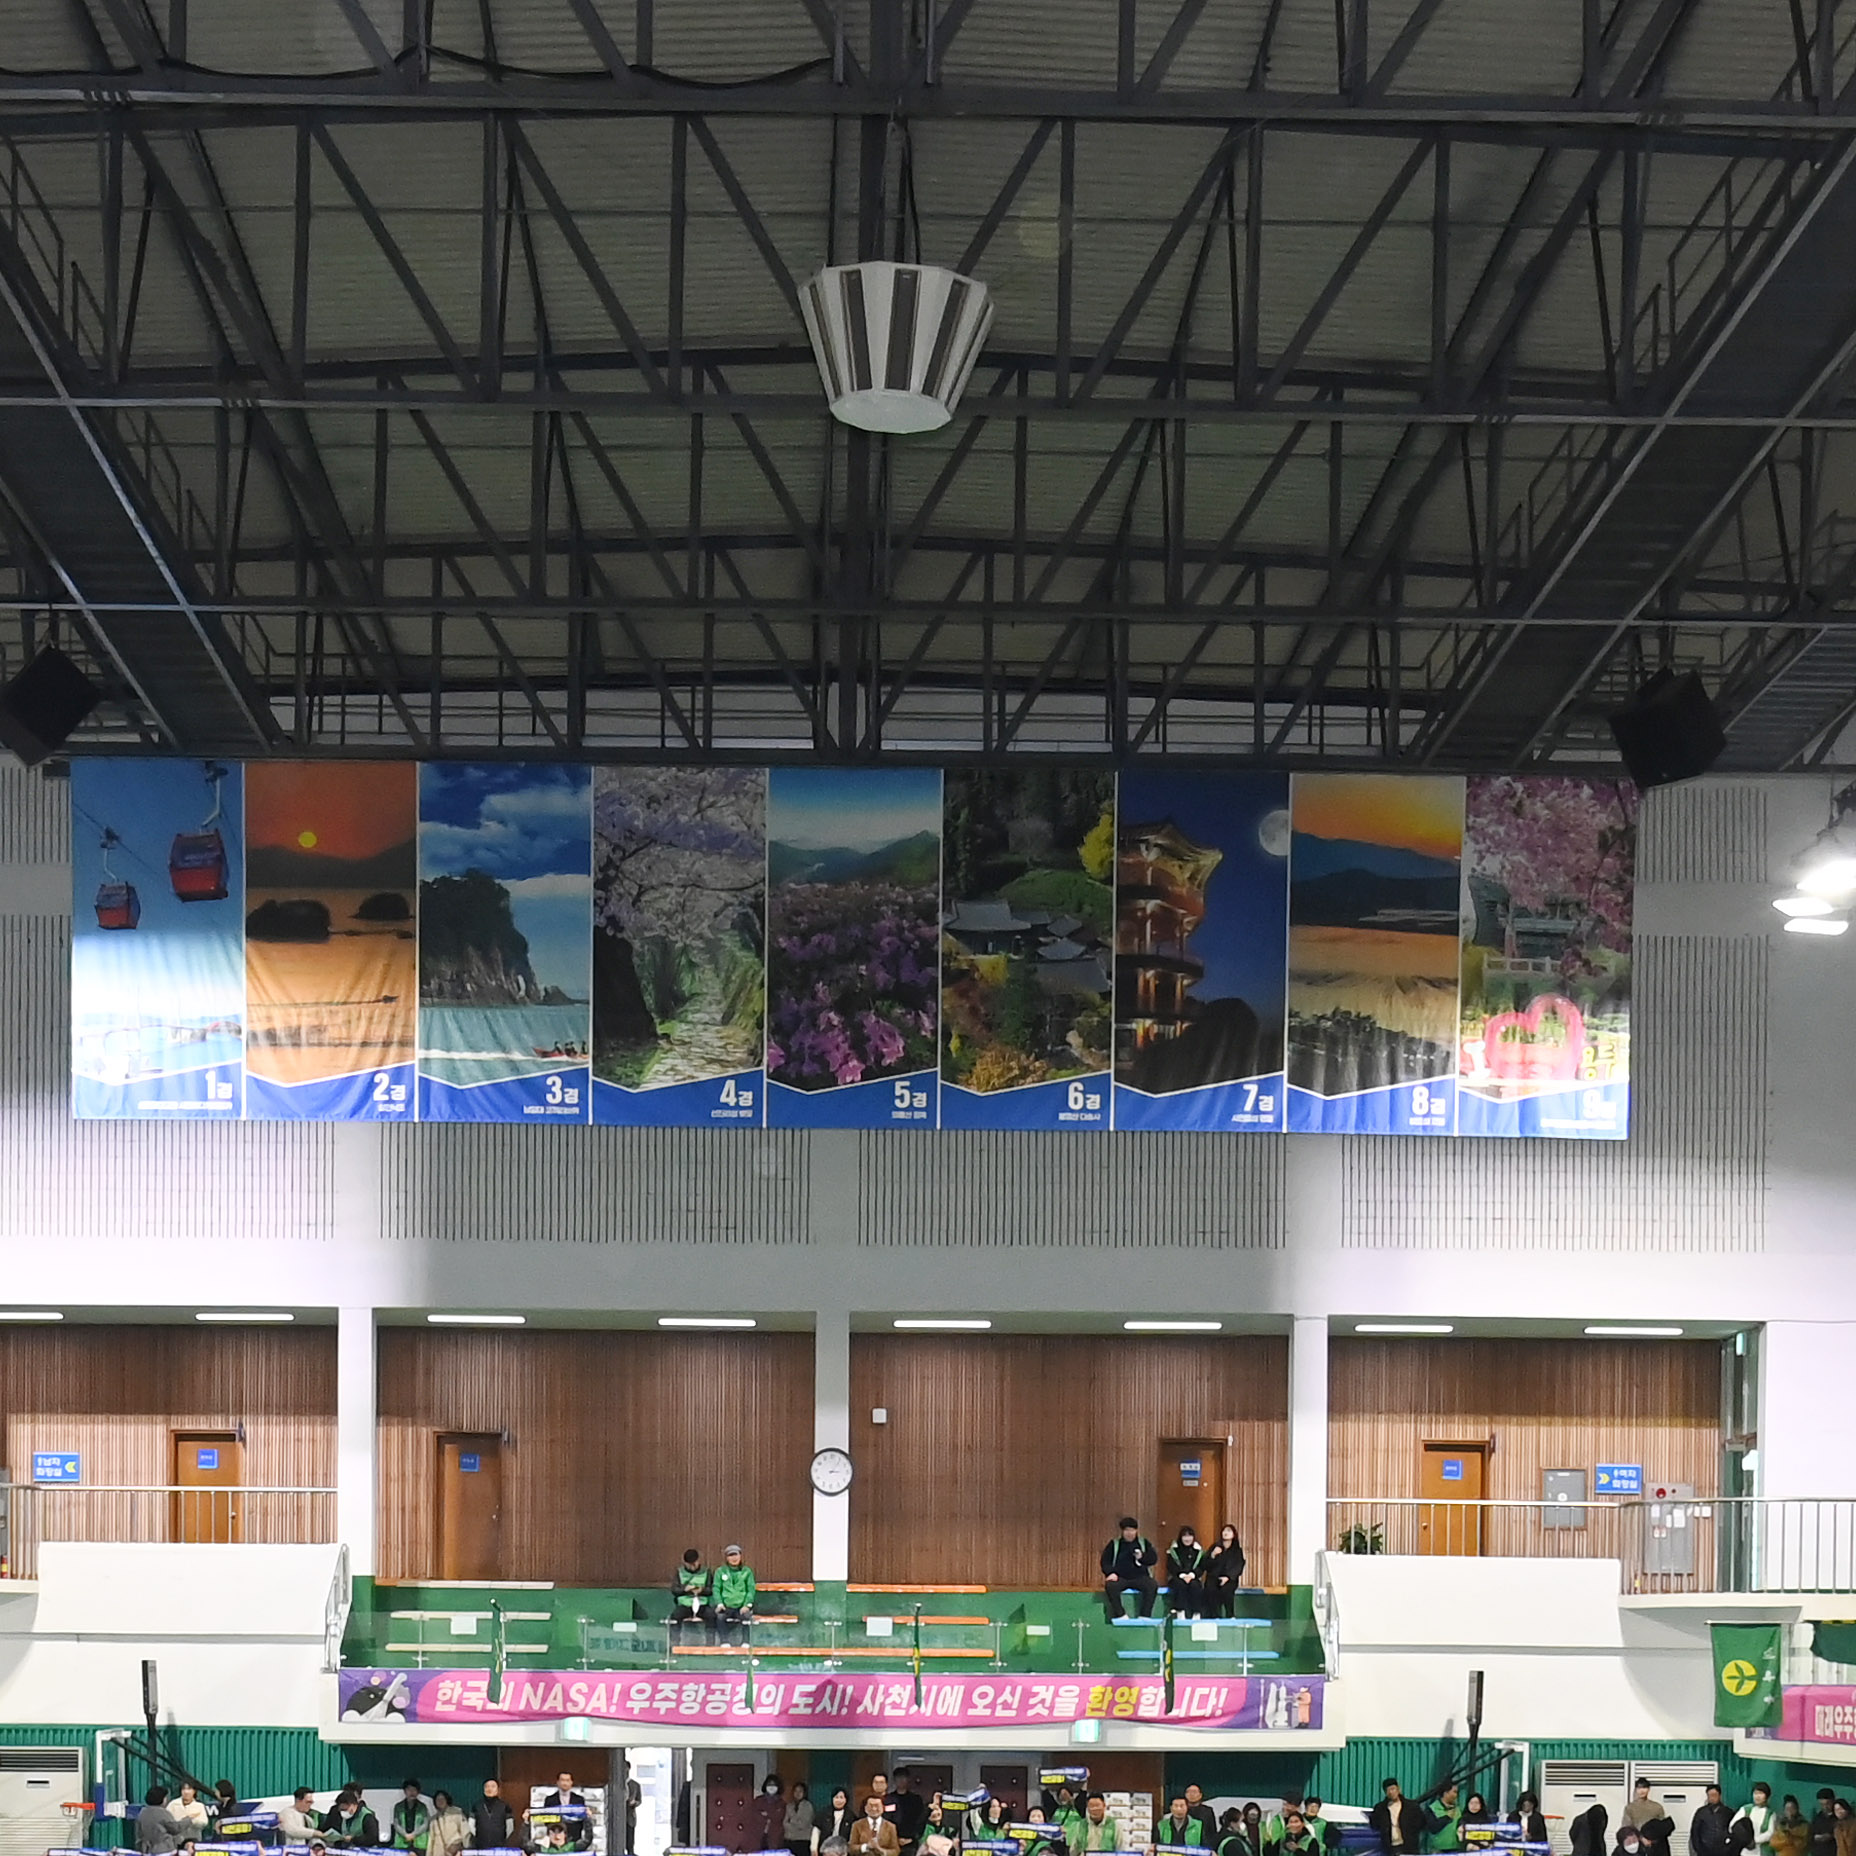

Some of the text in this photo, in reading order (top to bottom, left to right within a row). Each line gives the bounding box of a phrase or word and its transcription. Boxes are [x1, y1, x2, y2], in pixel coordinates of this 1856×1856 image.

[373, 1072, 406, 1101] 2경
[546, 1075, 579, 1104] 3경
[720, 1079, 753, 1107] 4경
[894, 1081, 927, 1108] 5경
[1068, 1082, 1101, 1110] 6경
[1243, 1084, 1274, 1112] 7경
[1412, 1086, 1446, 1114] 8경
[435, 1679, 1228, 1718] 한국의 NASA! 우주항공청의 도시! 사천시에 오신 것을 환영합니다!
